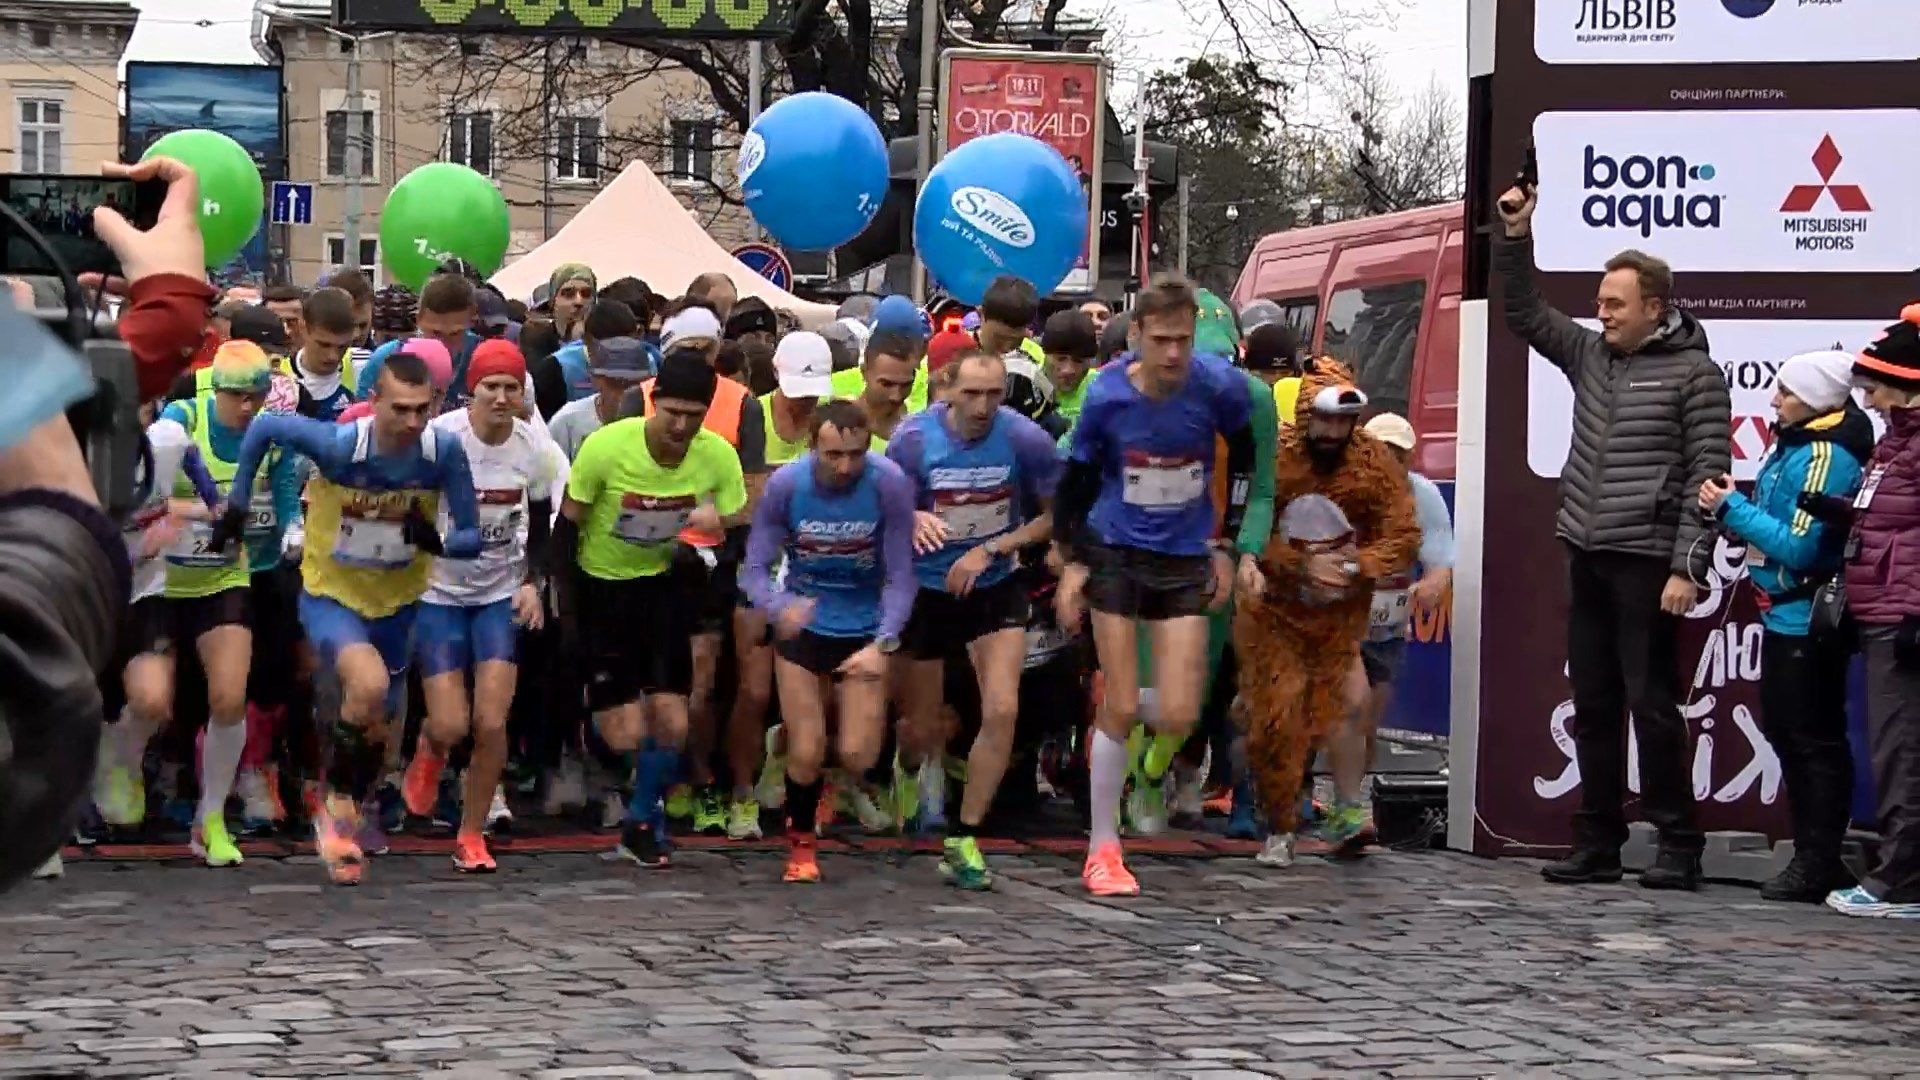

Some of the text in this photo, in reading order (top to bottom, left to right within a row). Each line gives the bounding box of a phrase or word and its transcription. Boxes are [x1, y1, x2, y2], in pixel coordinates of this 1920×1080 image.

[1575, 0, 1676, 29] ЛЬВІВ
[1583, 144, 1687, 189] bon
[956, 191, 1028, 243] Smile
[1582, 193, 1721, 238] aqua
[1784, 218, 1867, 232] MITSUBISHI
[1796, 236, 1854, 250] MOTORS
